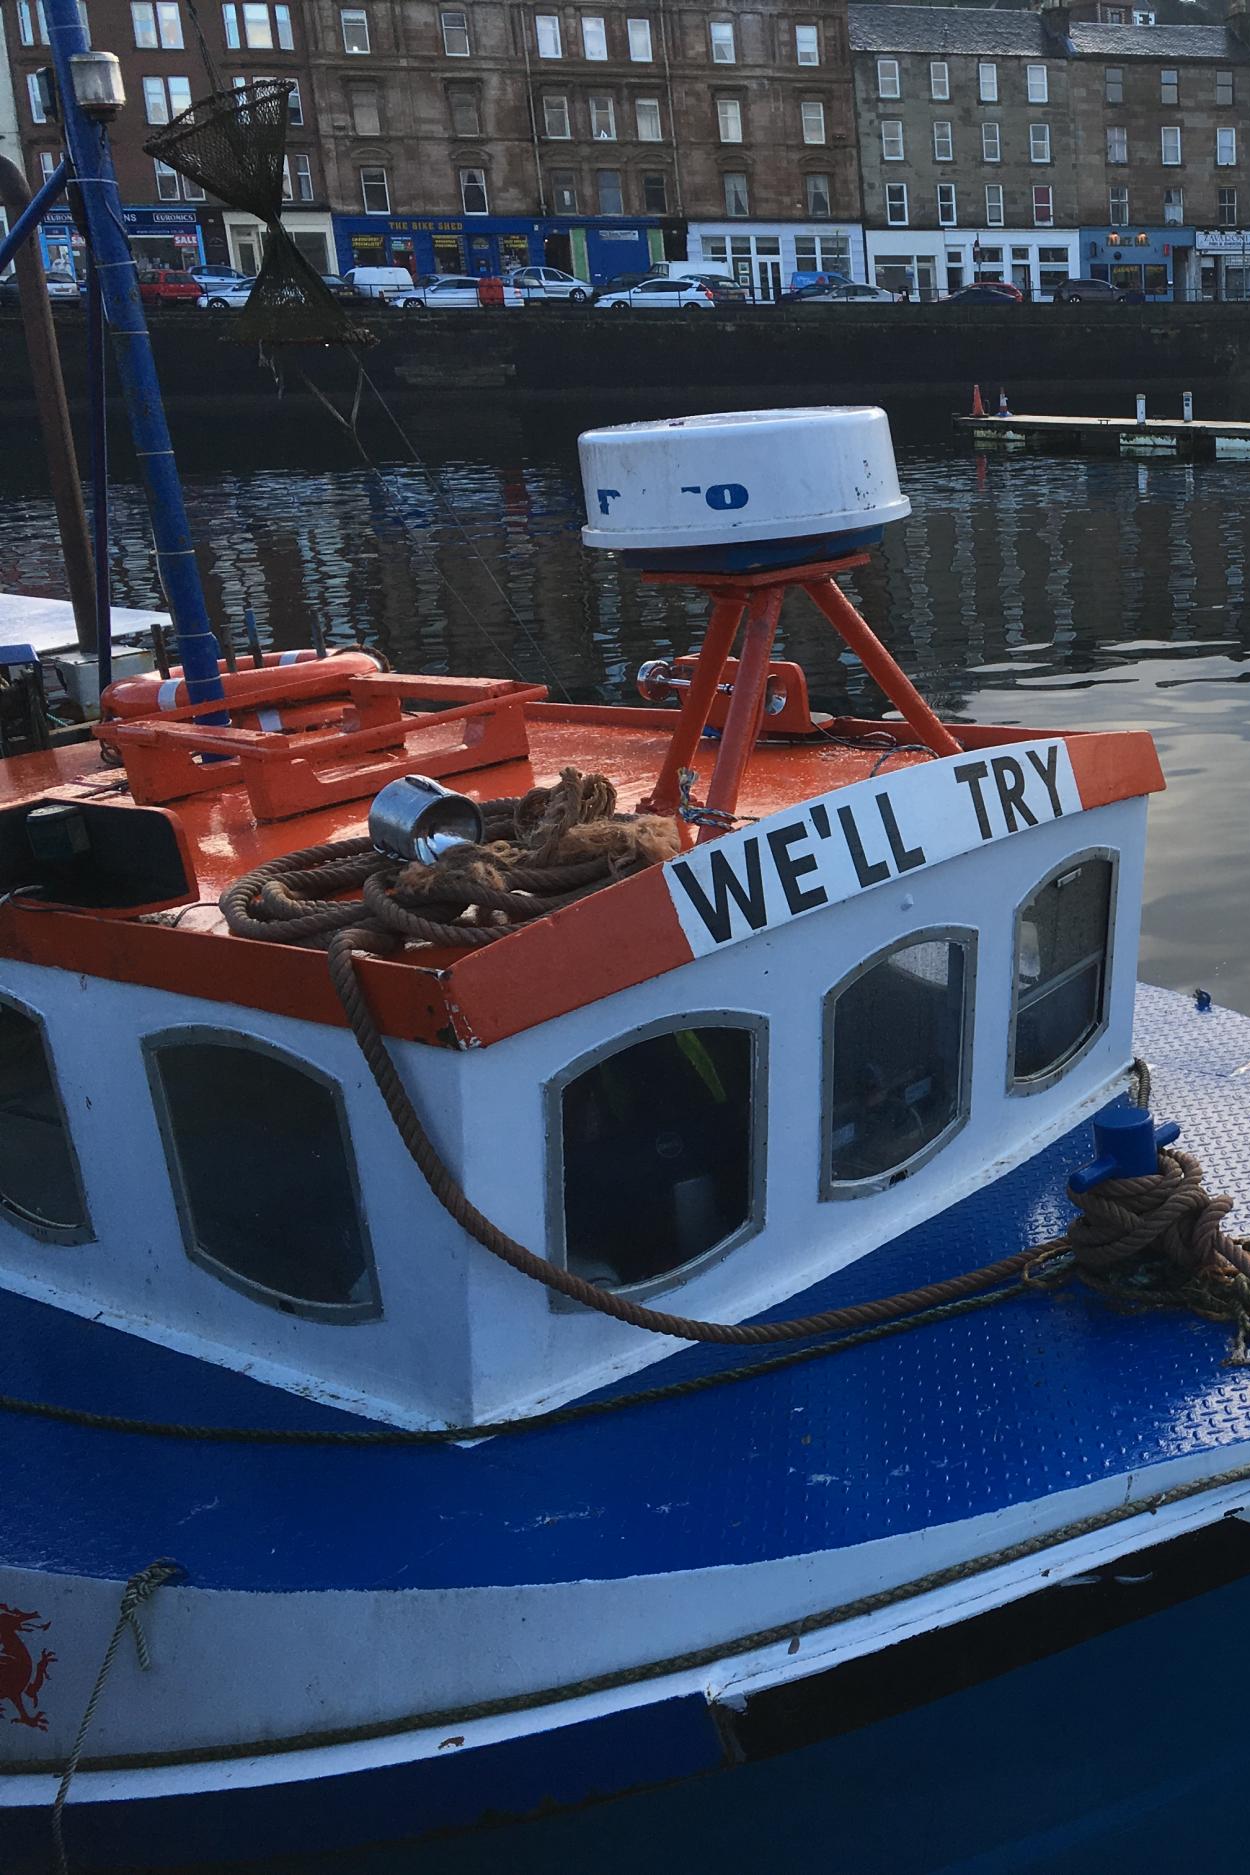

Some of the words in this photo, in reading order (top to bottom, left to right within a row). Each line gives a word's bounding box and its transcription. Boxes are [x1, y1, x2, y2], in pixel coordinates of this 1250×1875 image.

[46, 214, 73, 222] EURON
[123, 213, 137, 222] NS
[389, 222, 408, 231] THE
[412, 222, 434, 231] BIKE
[438, 222, 463, 231] SHED
[174, 236, 198, 244] SALE
[672, 792, 927, 944] WE'LL
[954, 745, 1064, 841] TRY
